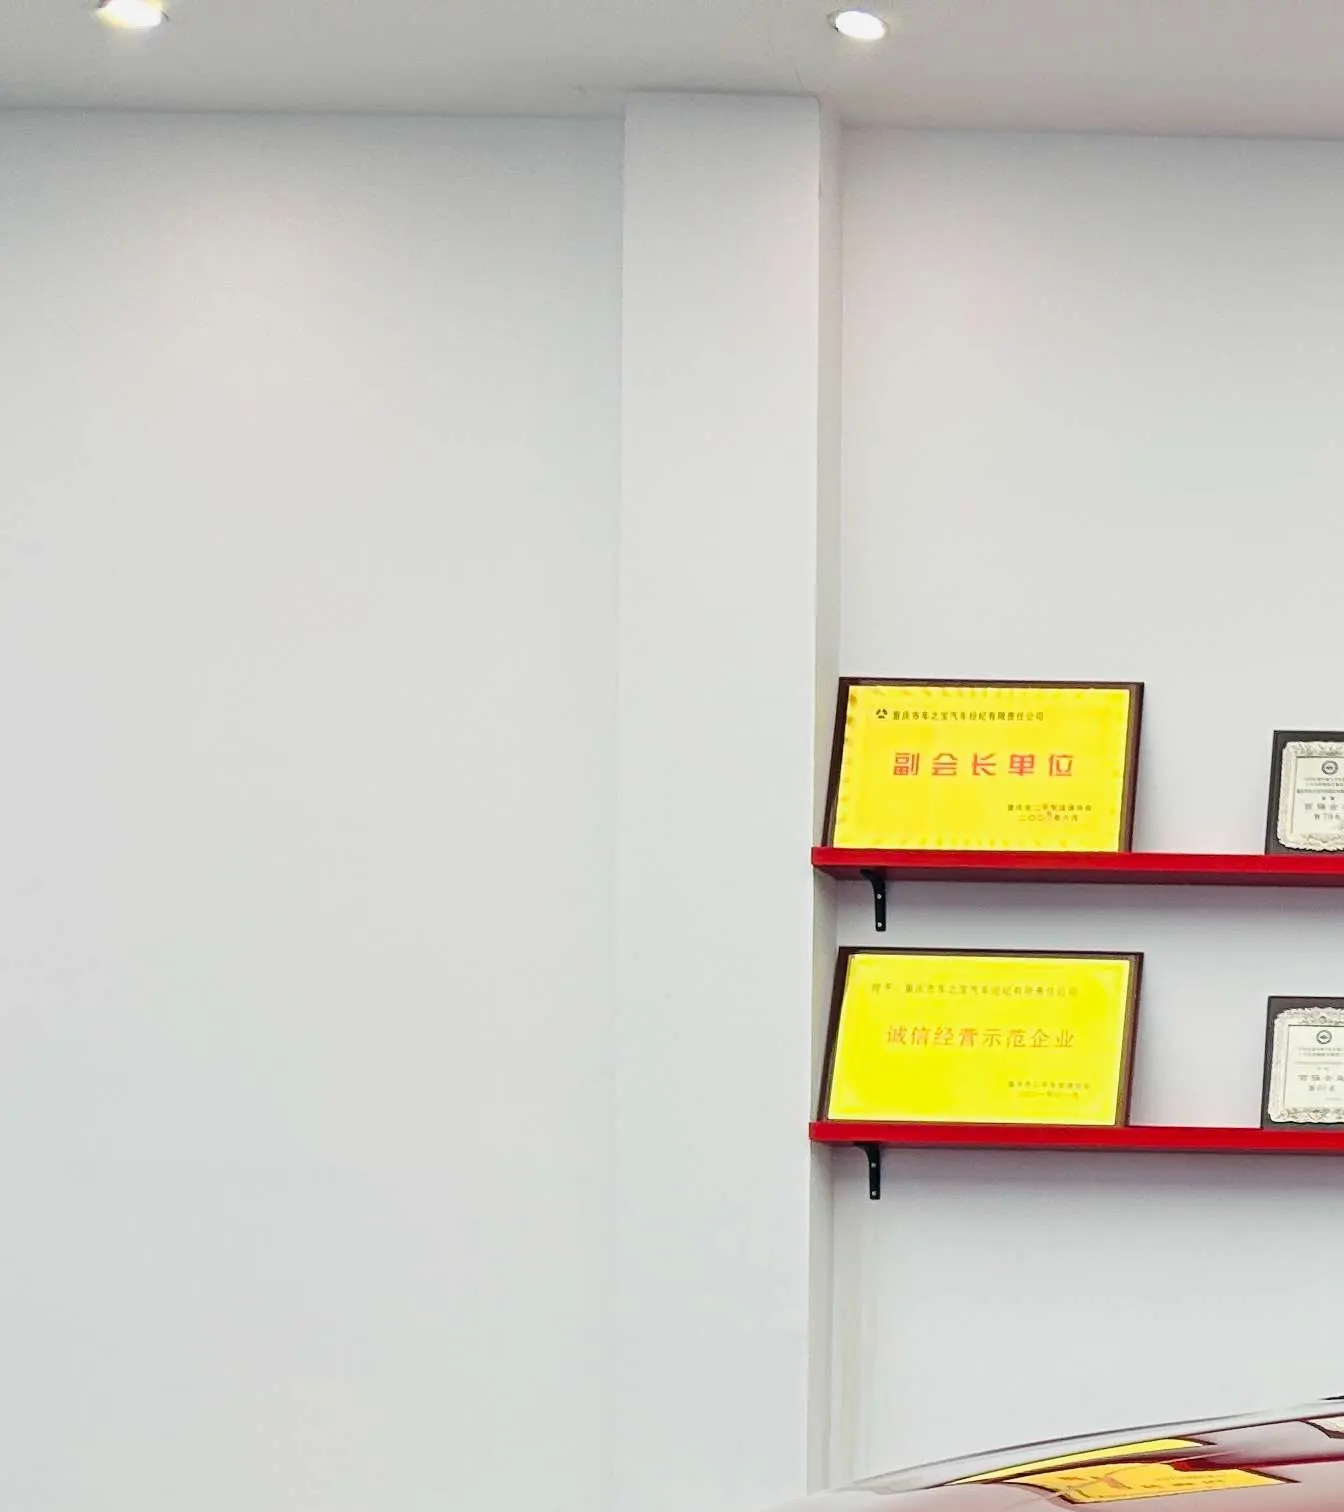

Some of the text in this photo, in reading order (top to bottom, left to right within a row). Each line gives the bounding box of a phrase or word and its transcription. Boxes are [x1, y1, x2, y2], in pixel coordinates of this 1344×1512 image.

[893, 752, 1074, 777] 副会长单位
[886, 1025, 1076, 1049] 诚信经营示范企业
